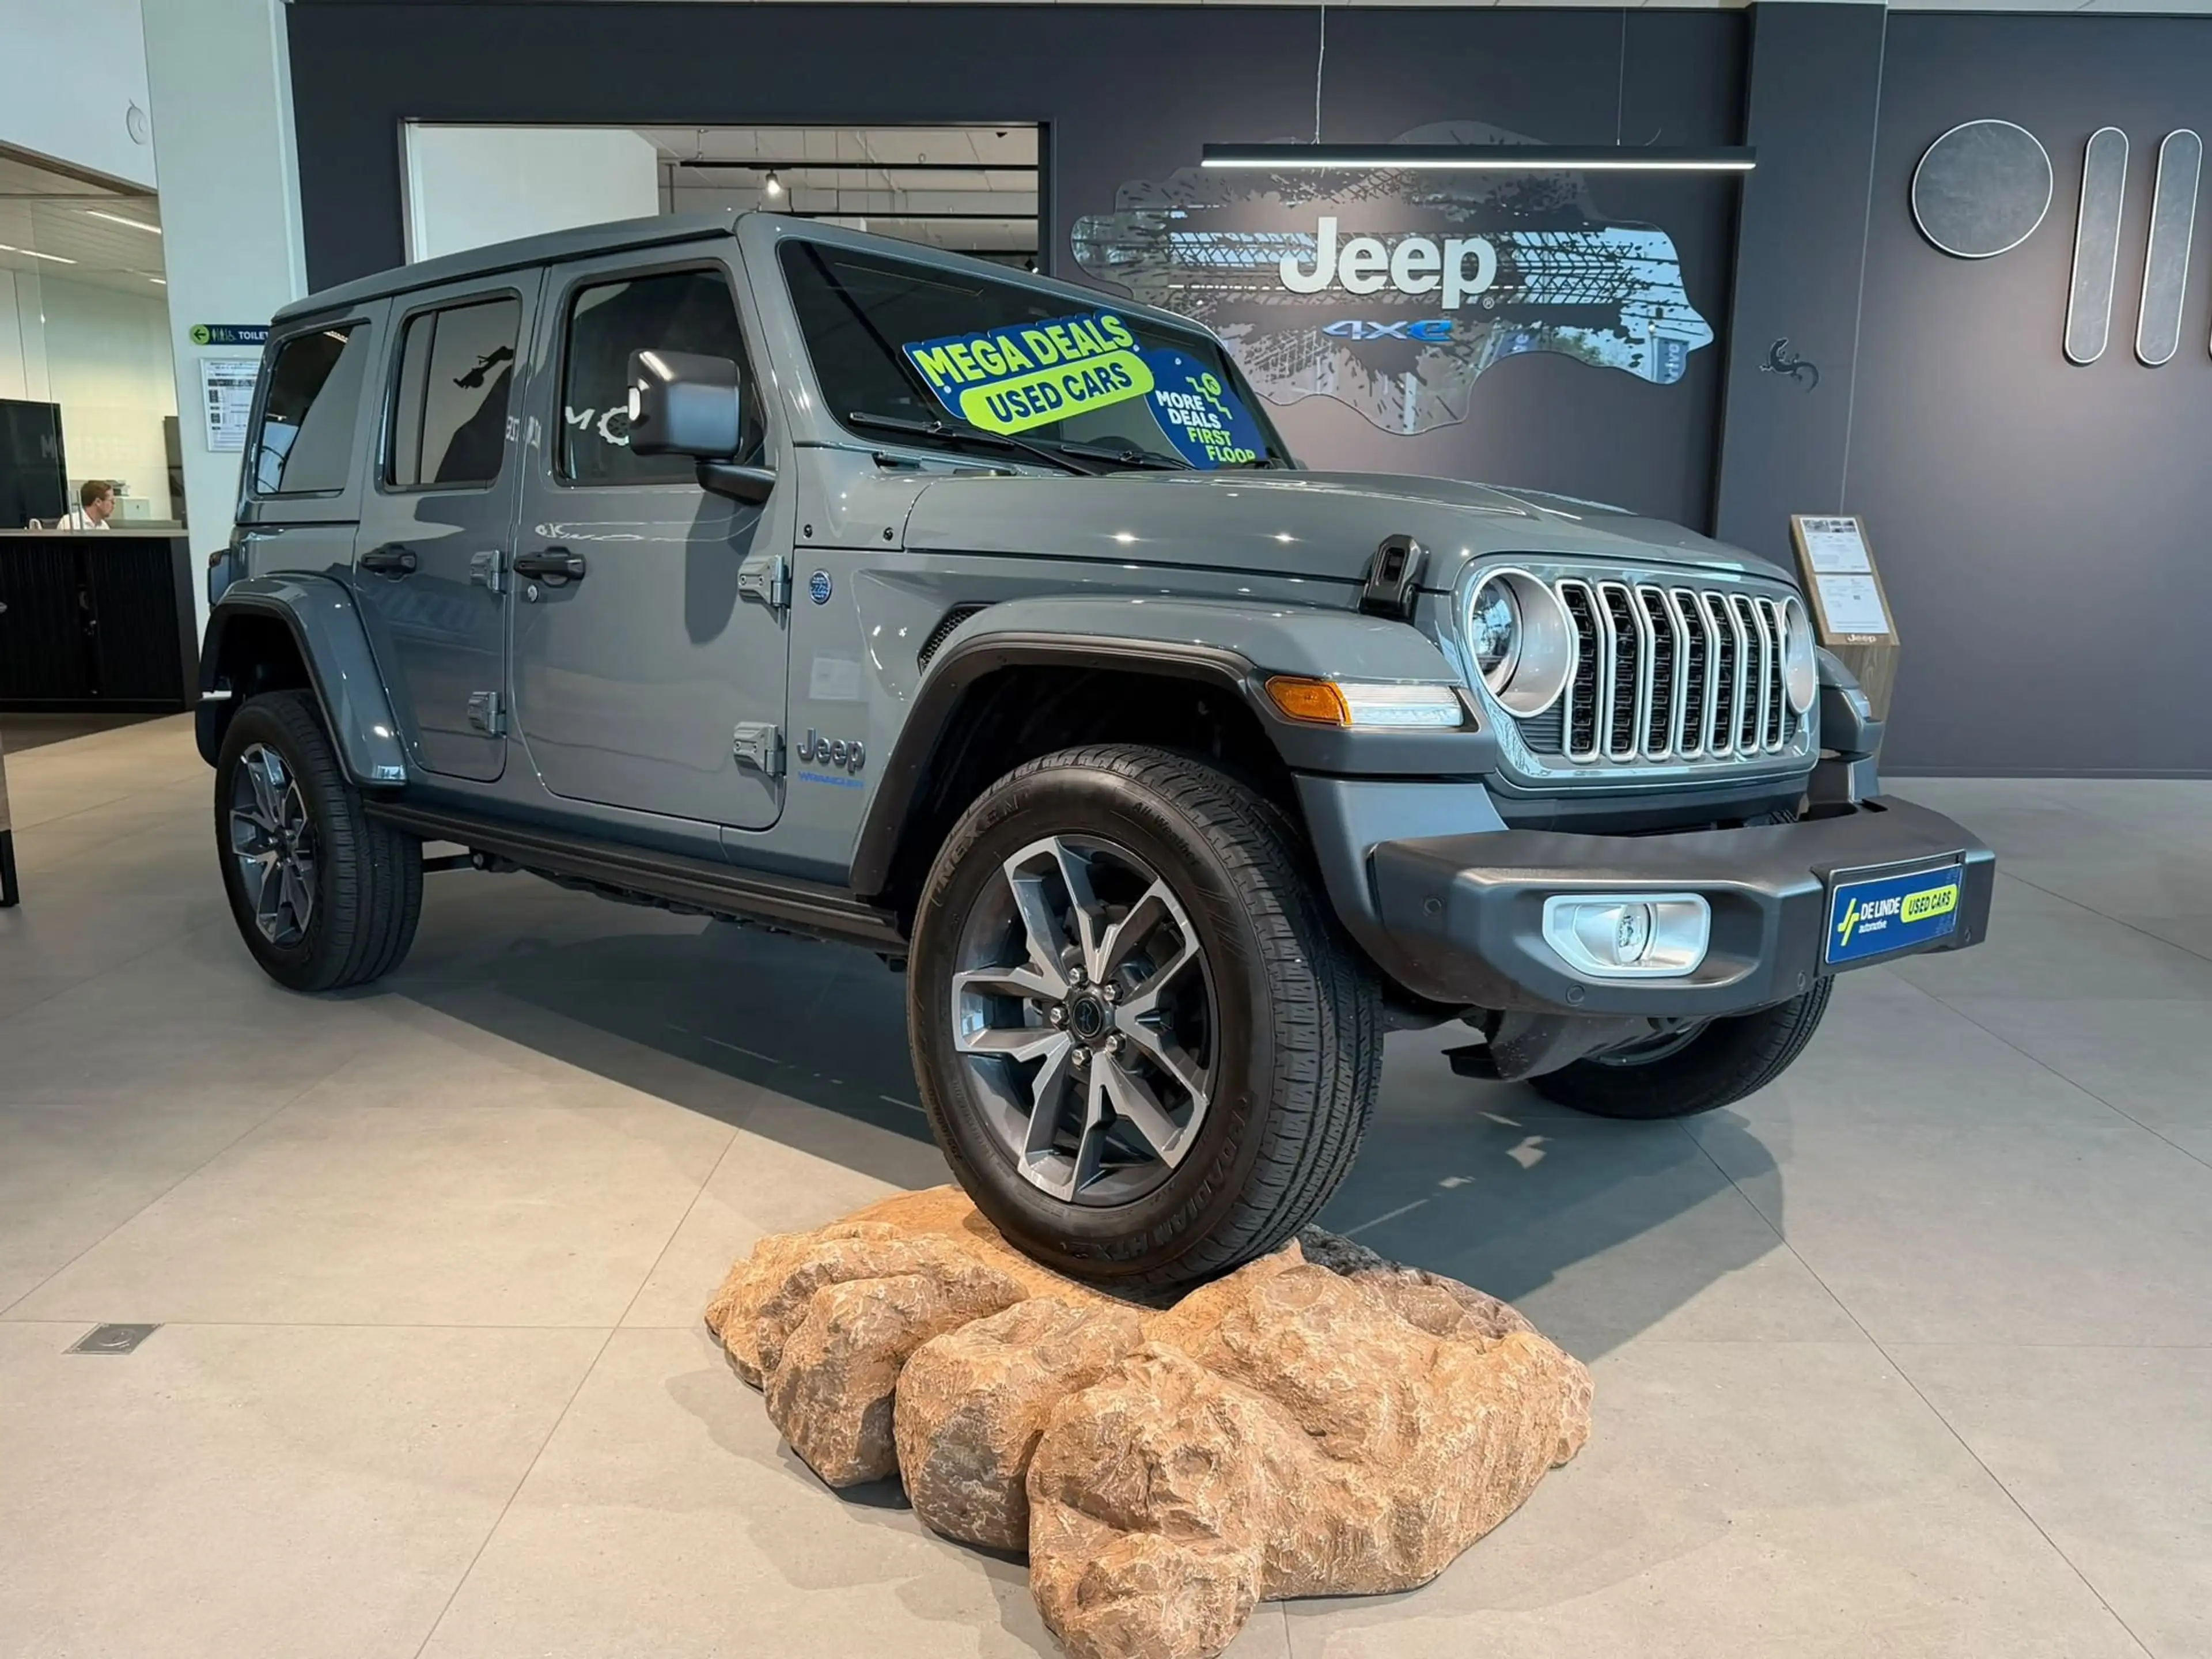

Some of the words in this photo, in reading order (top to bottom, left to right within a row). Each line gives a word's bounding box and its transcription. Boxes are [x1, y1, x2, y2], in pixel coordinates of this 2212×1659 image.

[1279, 217, 1497, 310] Jeep
[912, 335, 1035, 387] MEGA
[1021, 315, 1134, 365] DEALS
[986, 381, 1063, 423] USED
[1062, 362, 1133, 402] CARS
[1155, 390, 1206, 411] MORE
[1168, 408, 1222, 429] DEALS
[1187, 426, 1232, 446] FIRST
[796, 728, 865, 774] Jeep
[1861, 901, 1874, 920] DE
[1874, 897, 1901, 918] LINDE
[1908, 895, 1930, 915] USED
[1931, 891, 1951, 909] CARS
